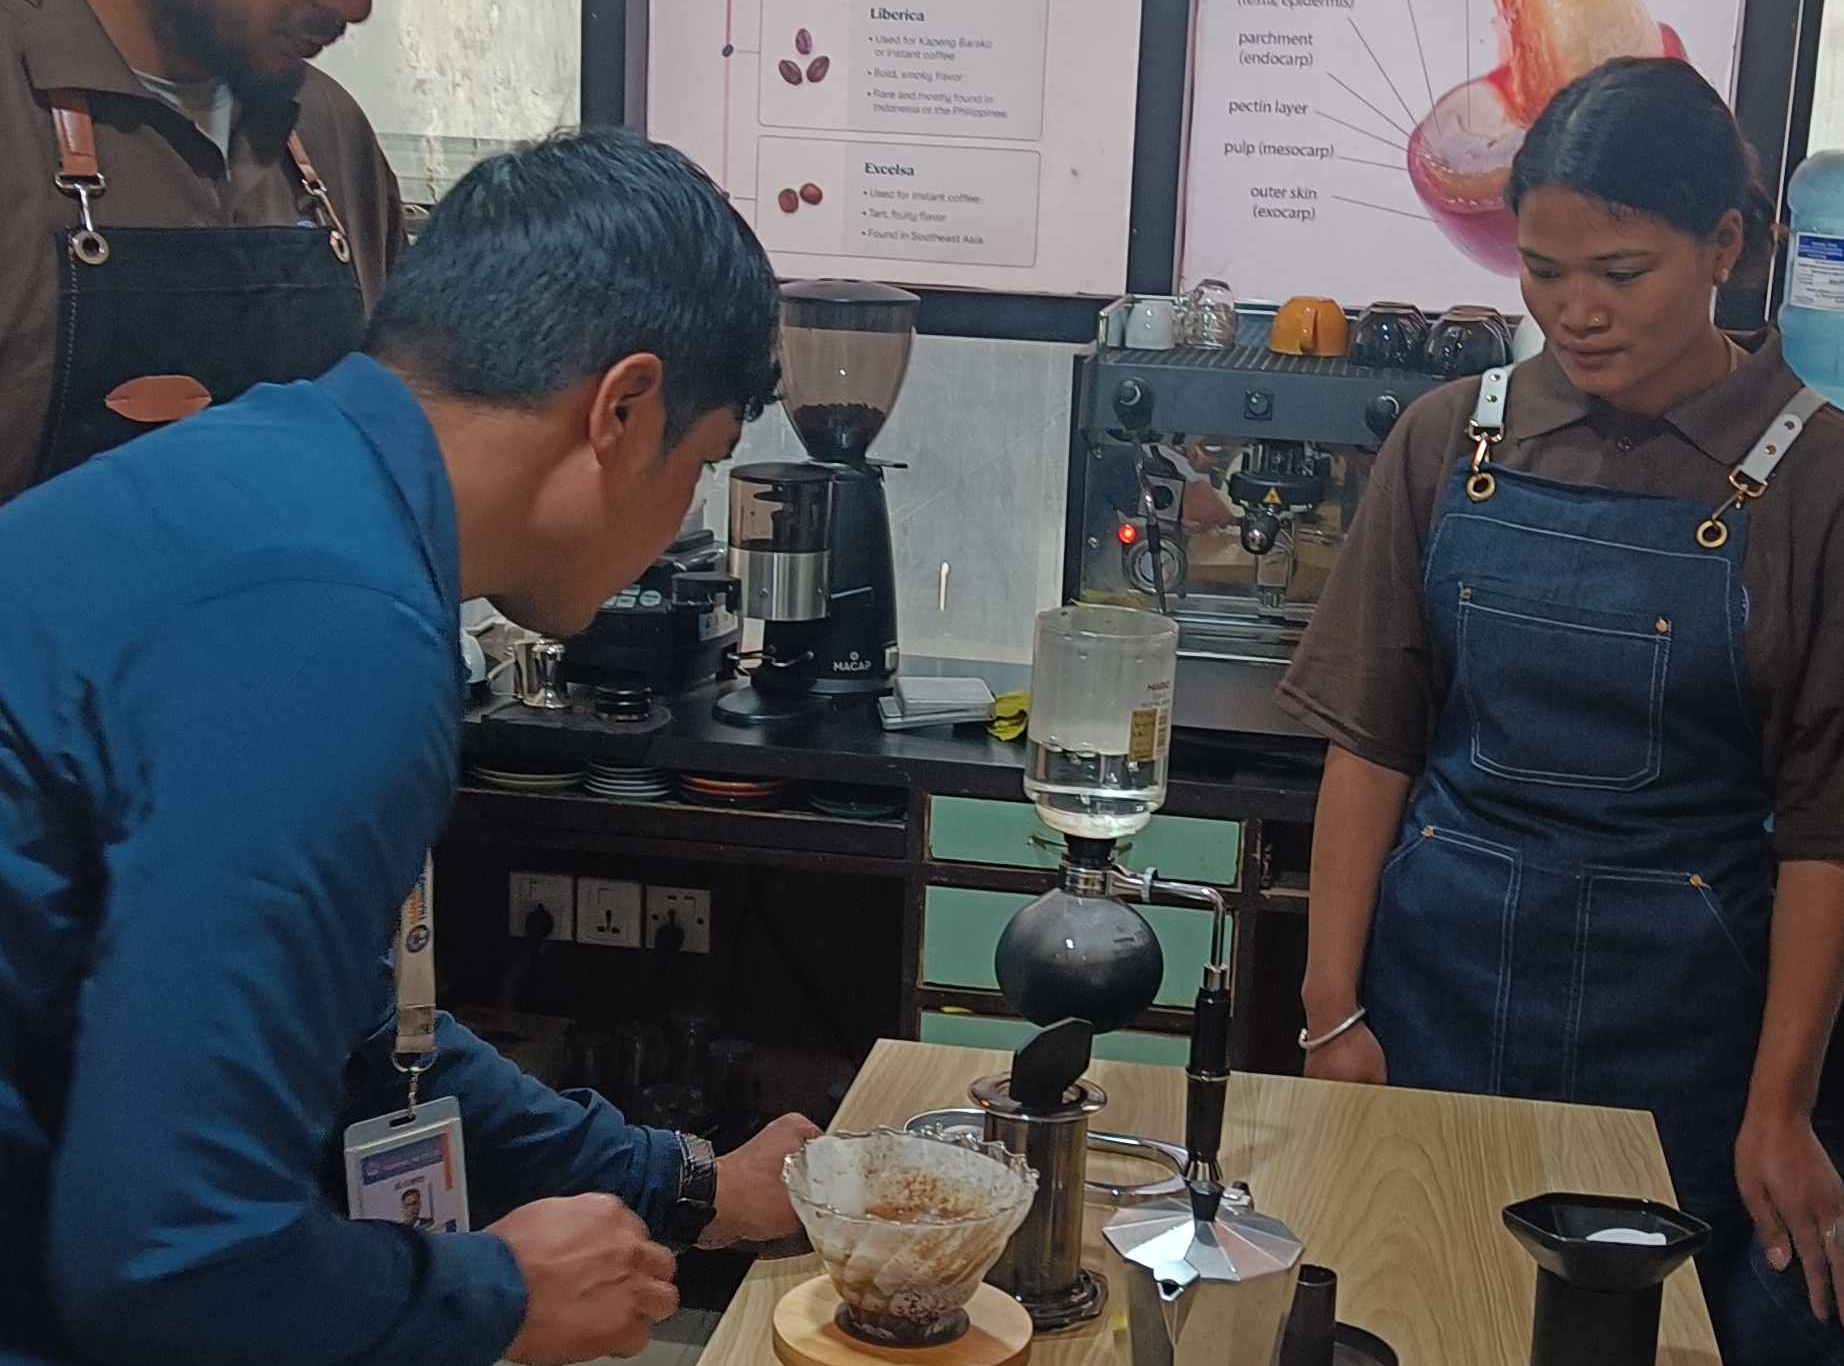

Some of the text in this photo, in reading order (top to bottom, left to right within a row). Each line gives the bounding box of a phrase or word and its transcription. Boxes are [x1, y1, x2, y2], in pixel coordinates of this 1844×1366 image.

[870, 7, 925, 22] Liberica
[875, 35, 901, 46] Used
[903, 36, 916, 46] for
[1238, 32, 1314, 47] parchment
[875, 48, 955, 61] or instant coffee
[1238, 51, 1314, 68] (endocarp)
[901, 70, 934, 83] smoky
[936, 70, 963, 82] flavor
[873, 88, 993, 104] Rare and mostly found in
[921, 105, 932, 115] or
[935, 105, 950, 116] the
[1229, 100, 1308, 117] pectin layer
[1224, 140, 1334, 158] pulp (mesocarp)
[865, 162, 915, 177] Excelsa
[869, 187, 980, 203] Used for instant coffee
[1250, 186, 1317, 200] outer skin
[920, 211, 946, 221] flavor
[1252, 205, 1316, 222] (exocarp)
[868, 228, 898, 239] Found
[911, 231, 960, 243] Southeast
[963, 234, 983, 244] Asia
[833, 661, 872, 671] MACAP
